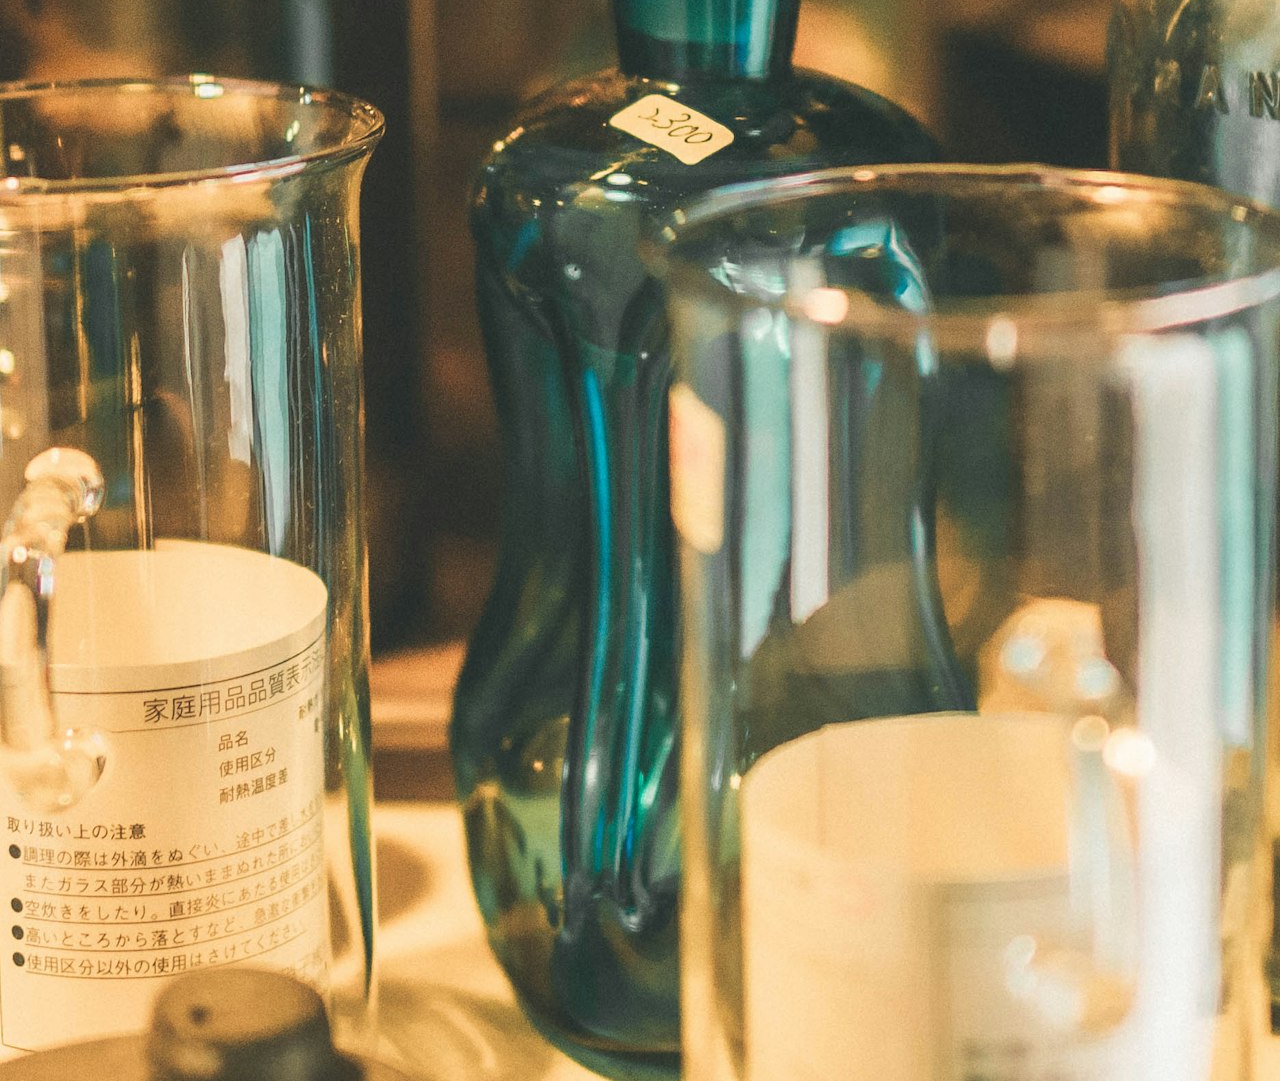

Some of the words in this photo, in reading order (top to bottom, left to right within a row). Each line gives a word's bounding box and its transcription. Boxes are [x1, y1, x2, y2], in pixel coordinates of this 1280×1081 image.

[218, 731, 249, 752] 品名
[219, 747, 277, 778] 使用区分
[7, 816, 147, 840] 取り扱い上の注意
